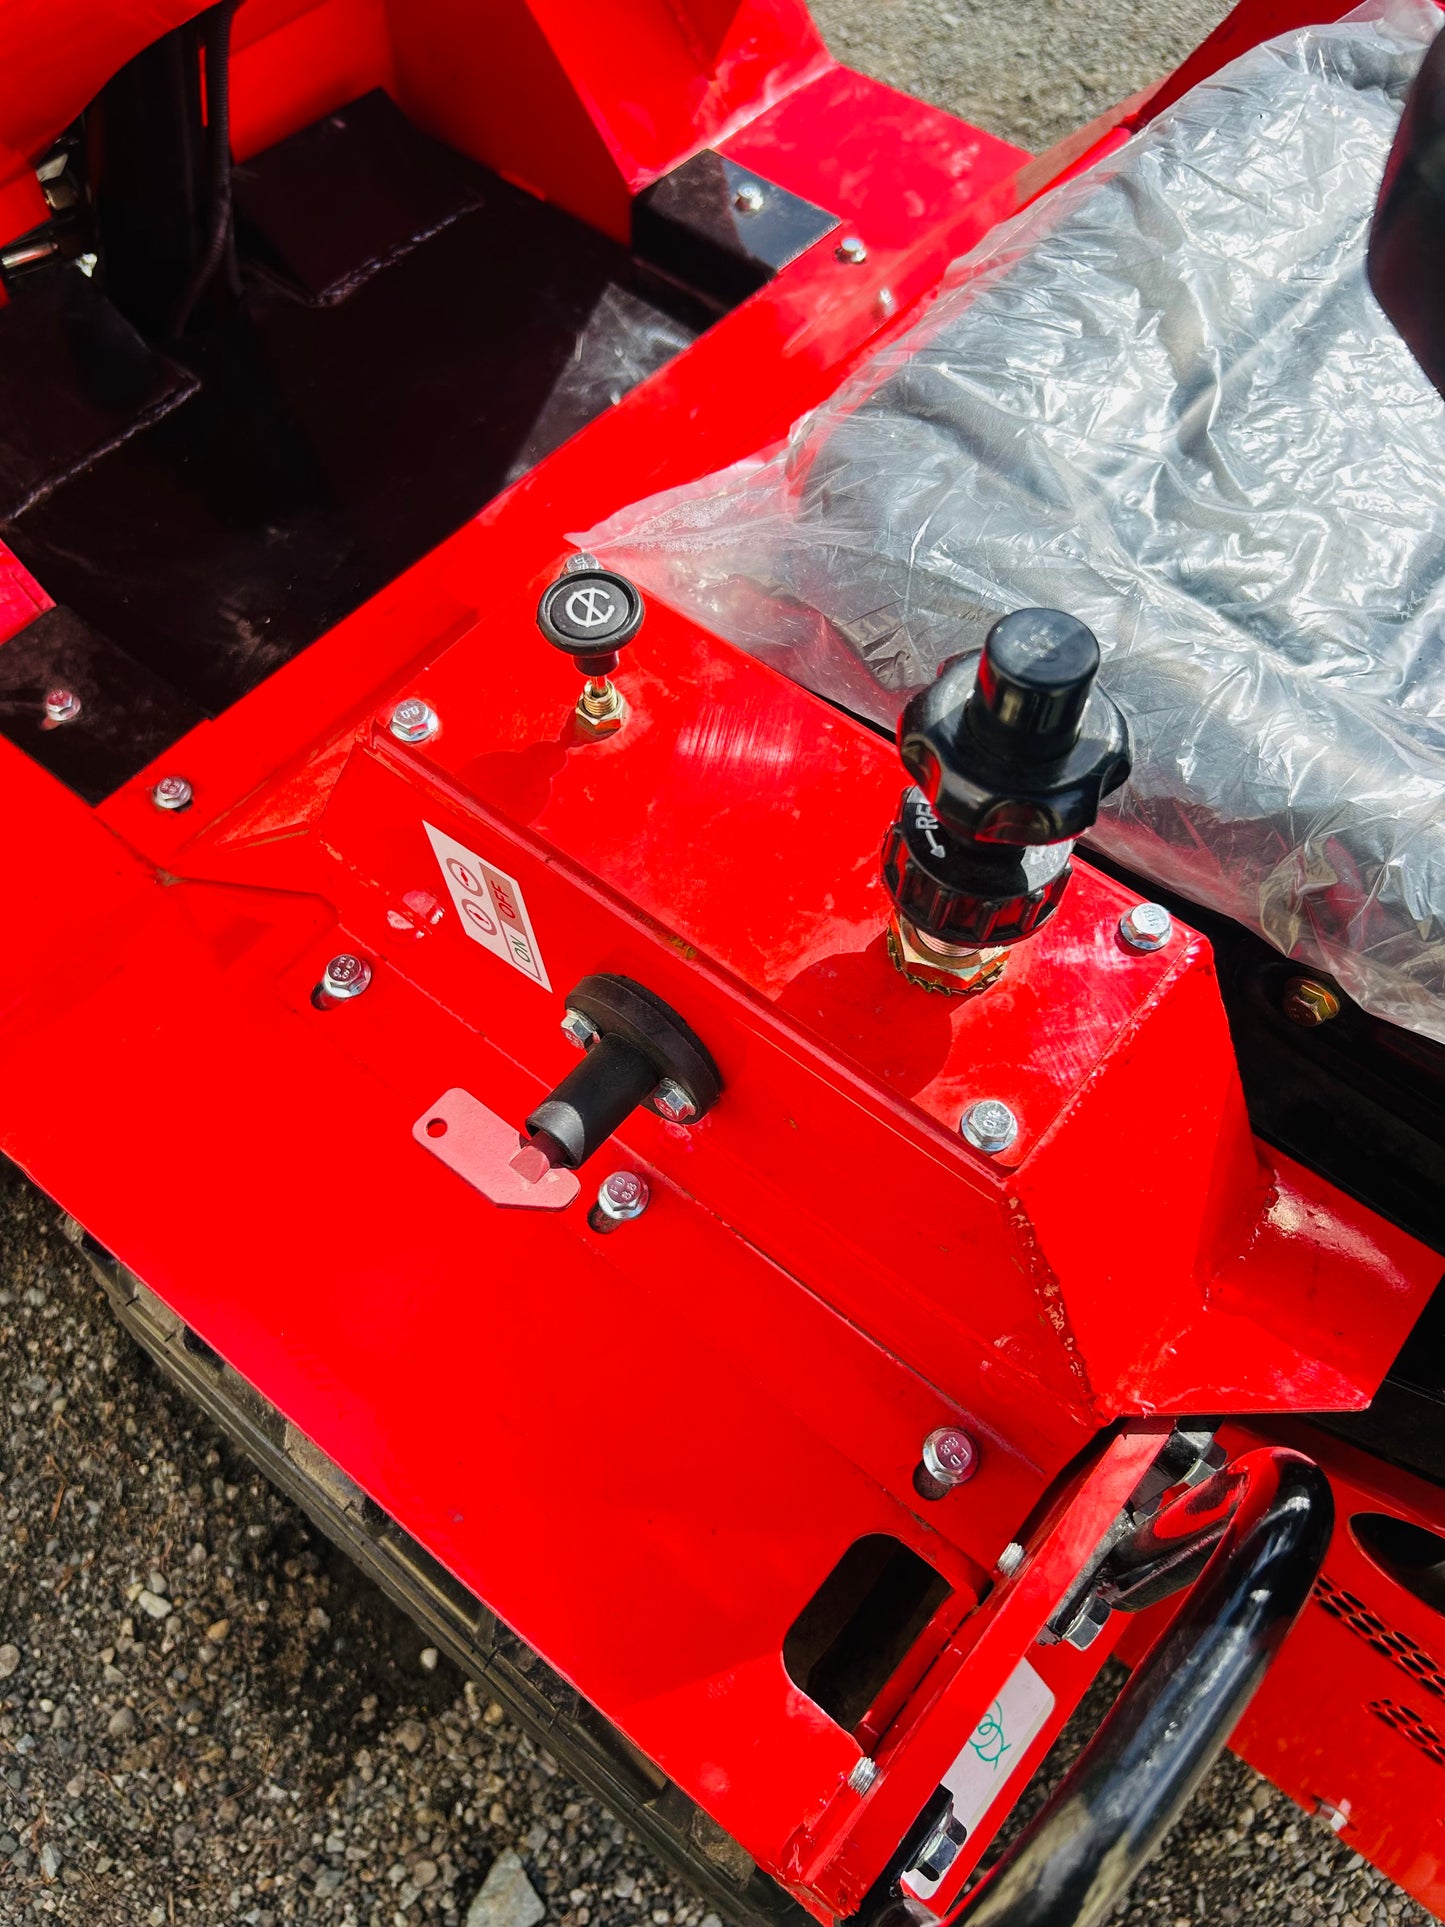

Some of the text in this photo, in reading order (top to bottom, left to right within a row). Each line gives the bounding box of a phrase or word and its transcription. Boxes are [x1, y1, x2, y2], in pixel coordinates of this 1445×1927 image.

[490, 880, 516, 919] OFF
[510, 934, 531, 963] ON
[333, 967, 350, 979] 8.8
[621, 1182, 637, 1200] 8.8
